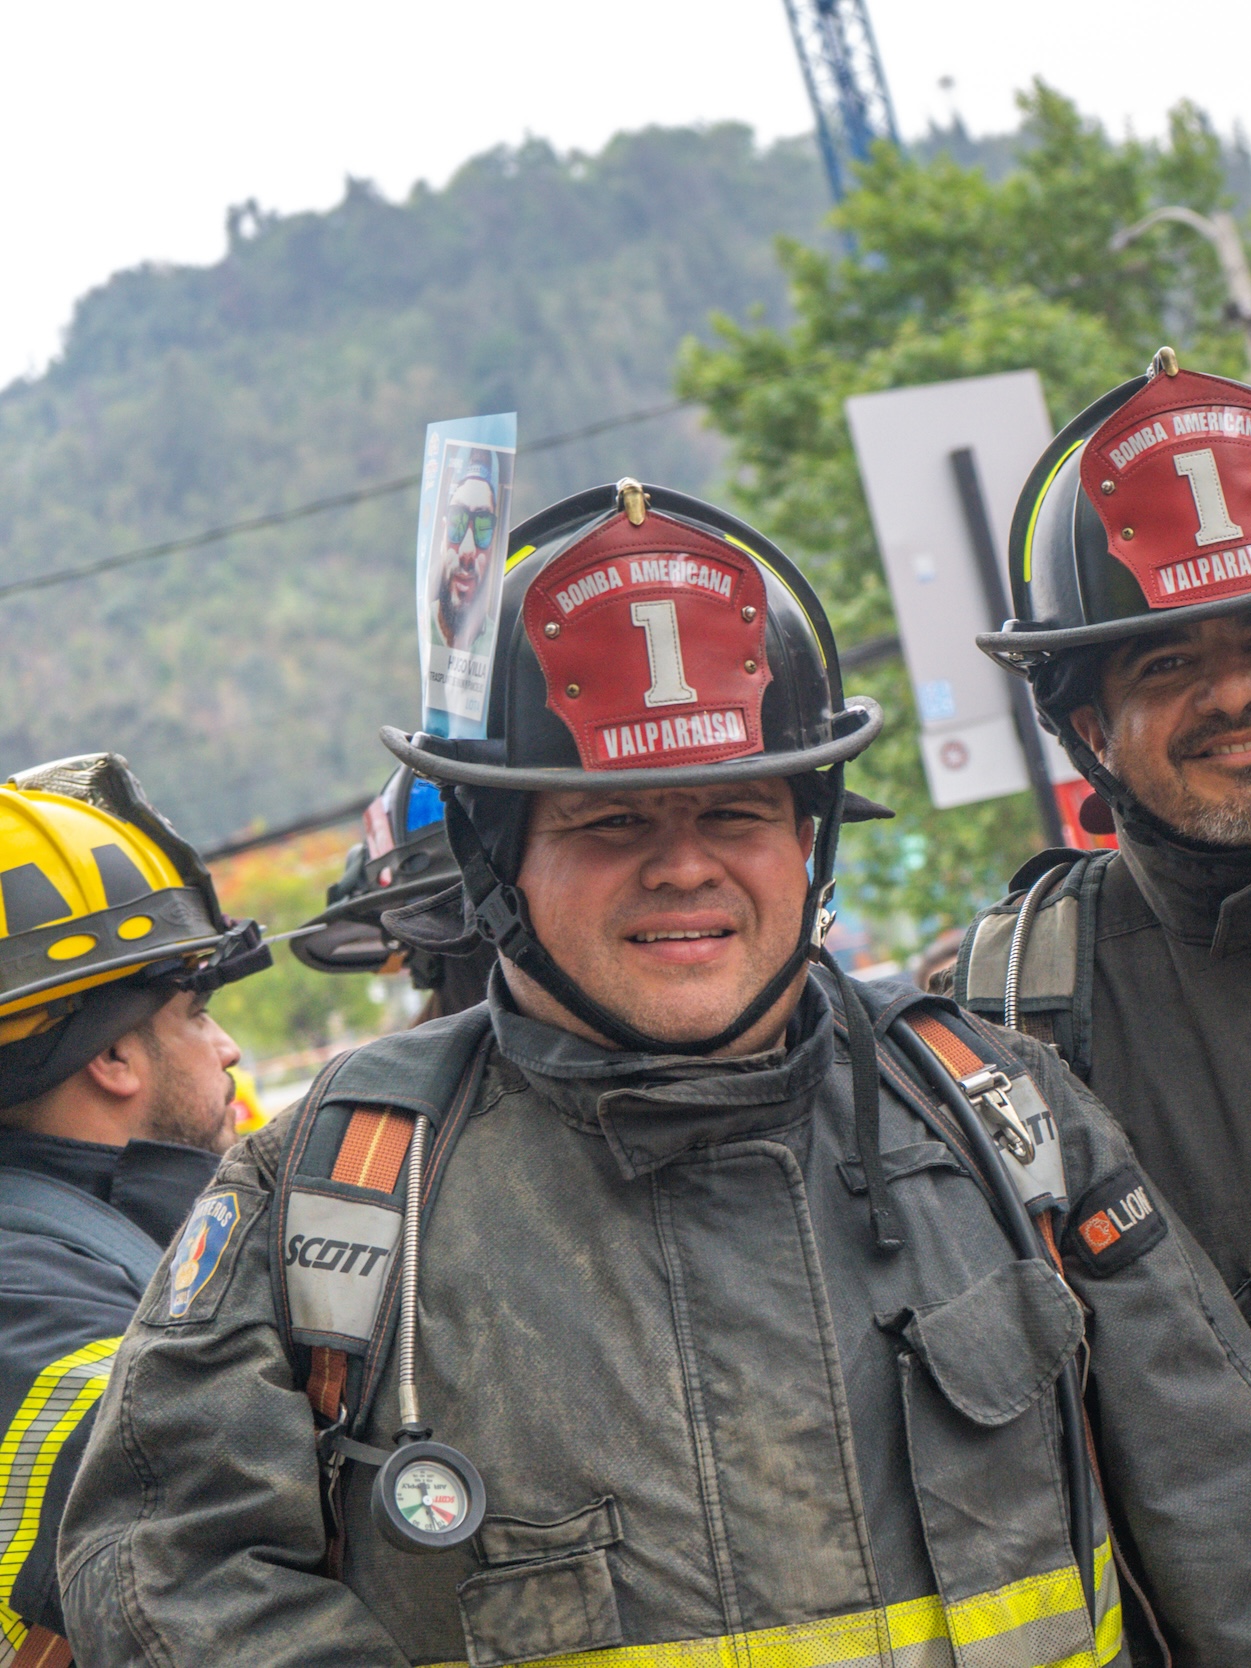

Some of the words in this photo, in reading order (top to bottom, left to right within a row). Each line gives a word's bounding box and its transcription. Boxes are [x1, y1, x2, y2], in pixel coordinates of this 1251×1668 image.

[1108, 422, 1168, 470] BOMBA
[1173, 448, 1244, 547] 1
[556, 566, 623, 615] BOMBA
[630, 559, 732, 599] AMERICANA
[629, 600, 698, 708] 1
[602, 711, 741, 760] VALPARAISO
[1107, 1185, 1154, 1233] LION
[285, 1233, 390, 1277] SCOTT
